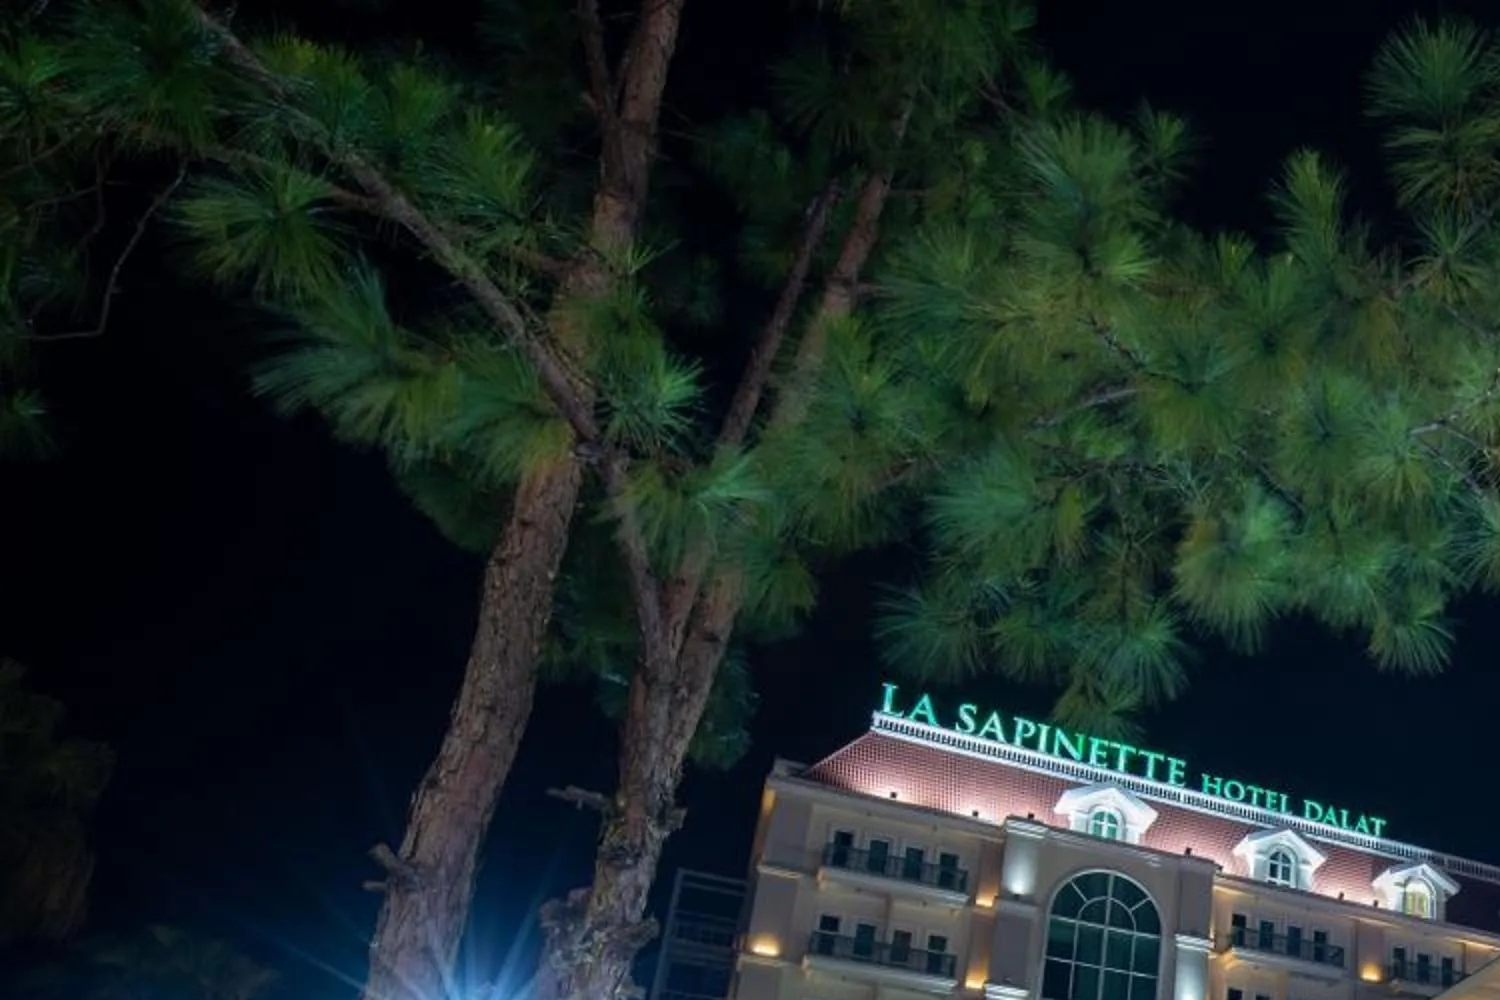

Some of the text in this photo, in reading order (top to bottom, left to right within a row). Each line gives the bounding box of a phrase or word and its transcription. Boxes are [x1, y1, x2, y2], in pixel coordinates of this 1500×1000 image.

[881, 682, 1388, 838] LA SAPINETTE HOTEL DALAT
